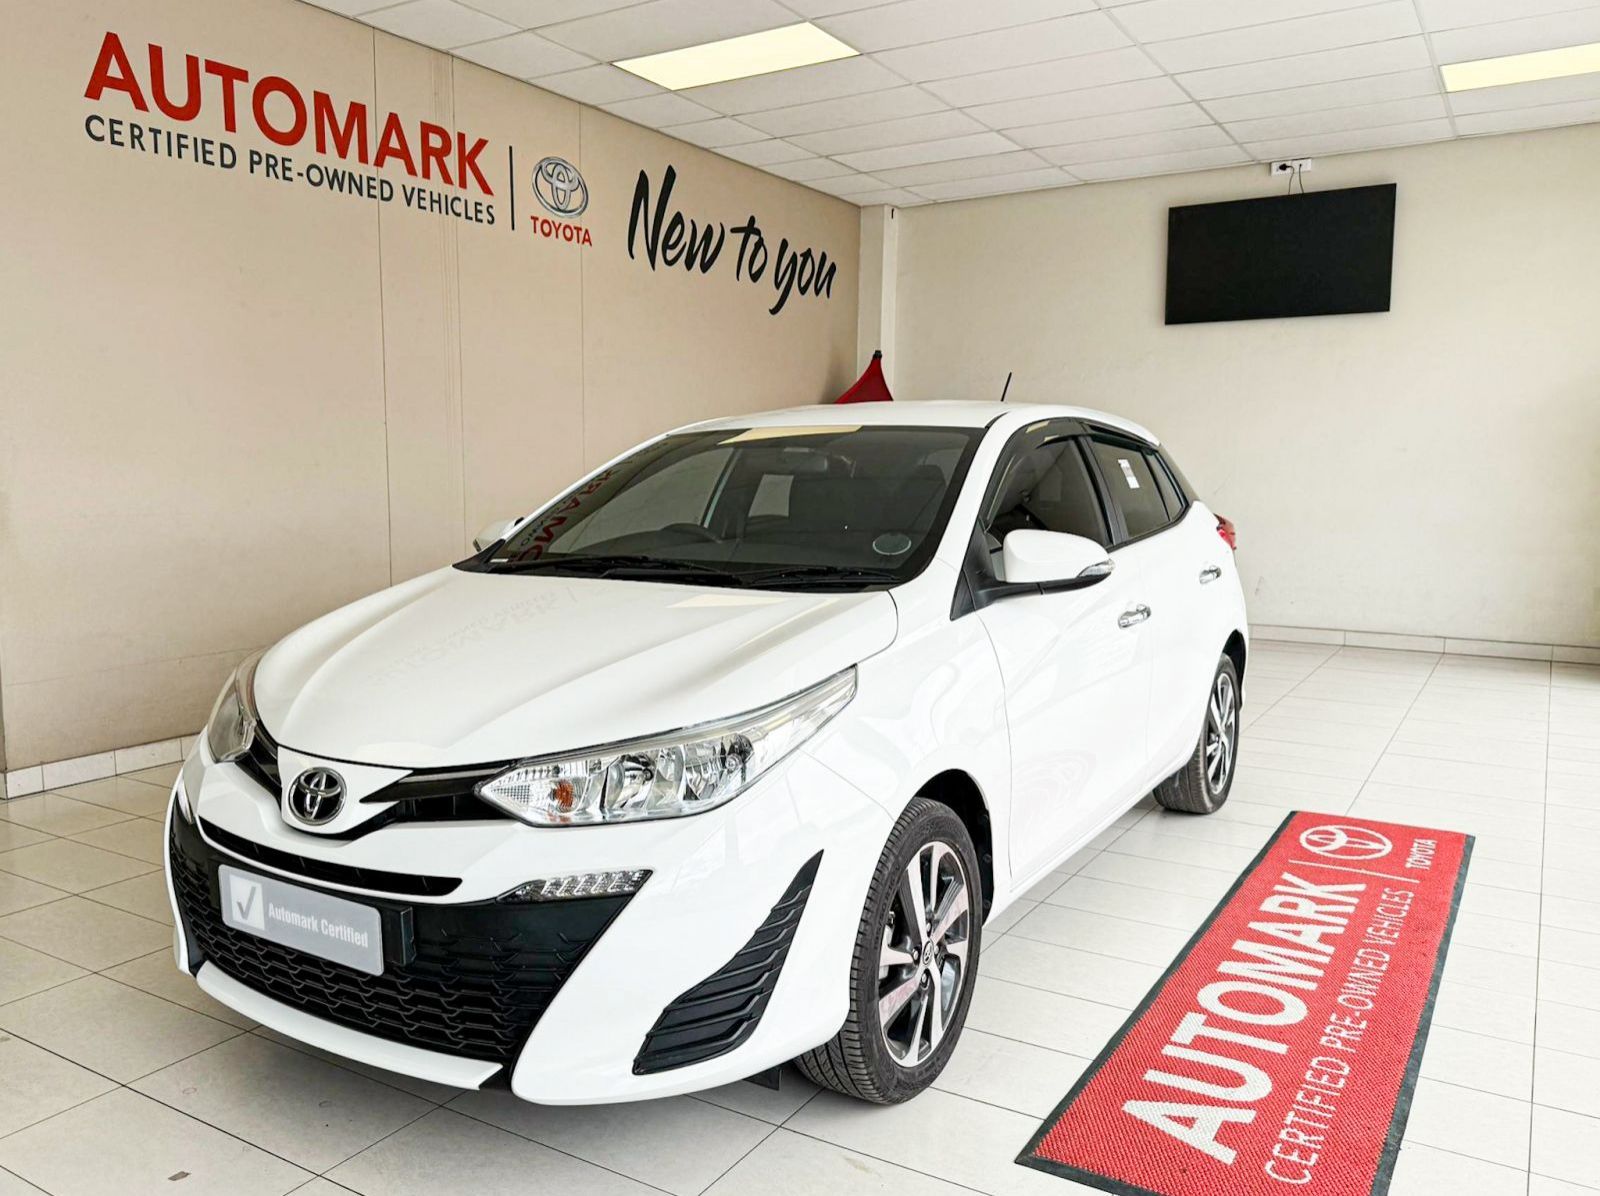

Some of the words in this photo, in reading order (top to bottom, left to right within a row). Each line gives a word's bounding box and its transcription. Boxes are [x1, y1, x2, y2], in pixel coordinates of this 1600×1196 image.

[84, 31, 494, 196] AUTOMARK
[85, 114, 237, 169] CERTIFIED
[249, 149, 394, 202] PRE-OWNED
[401, 184, 496, 225] VEHICLES
[530, 215, 592, 247] TOYOTA
[627, 165, 725, 272] New
[730, 215, 768, 283] to
[768, 238, 837, 315] you
[268, 902, 318, 932] Automark
[321, 918, 369, 948] Certified
[1121, 872, 1367, 1166] AUTOMARK
[1264, 1056, 1351, 1185] CERTIFIED
[1320, 949, 1391, 1054] PRE-OWNED
[1362, 888, 1415, 950] VEHICLES
